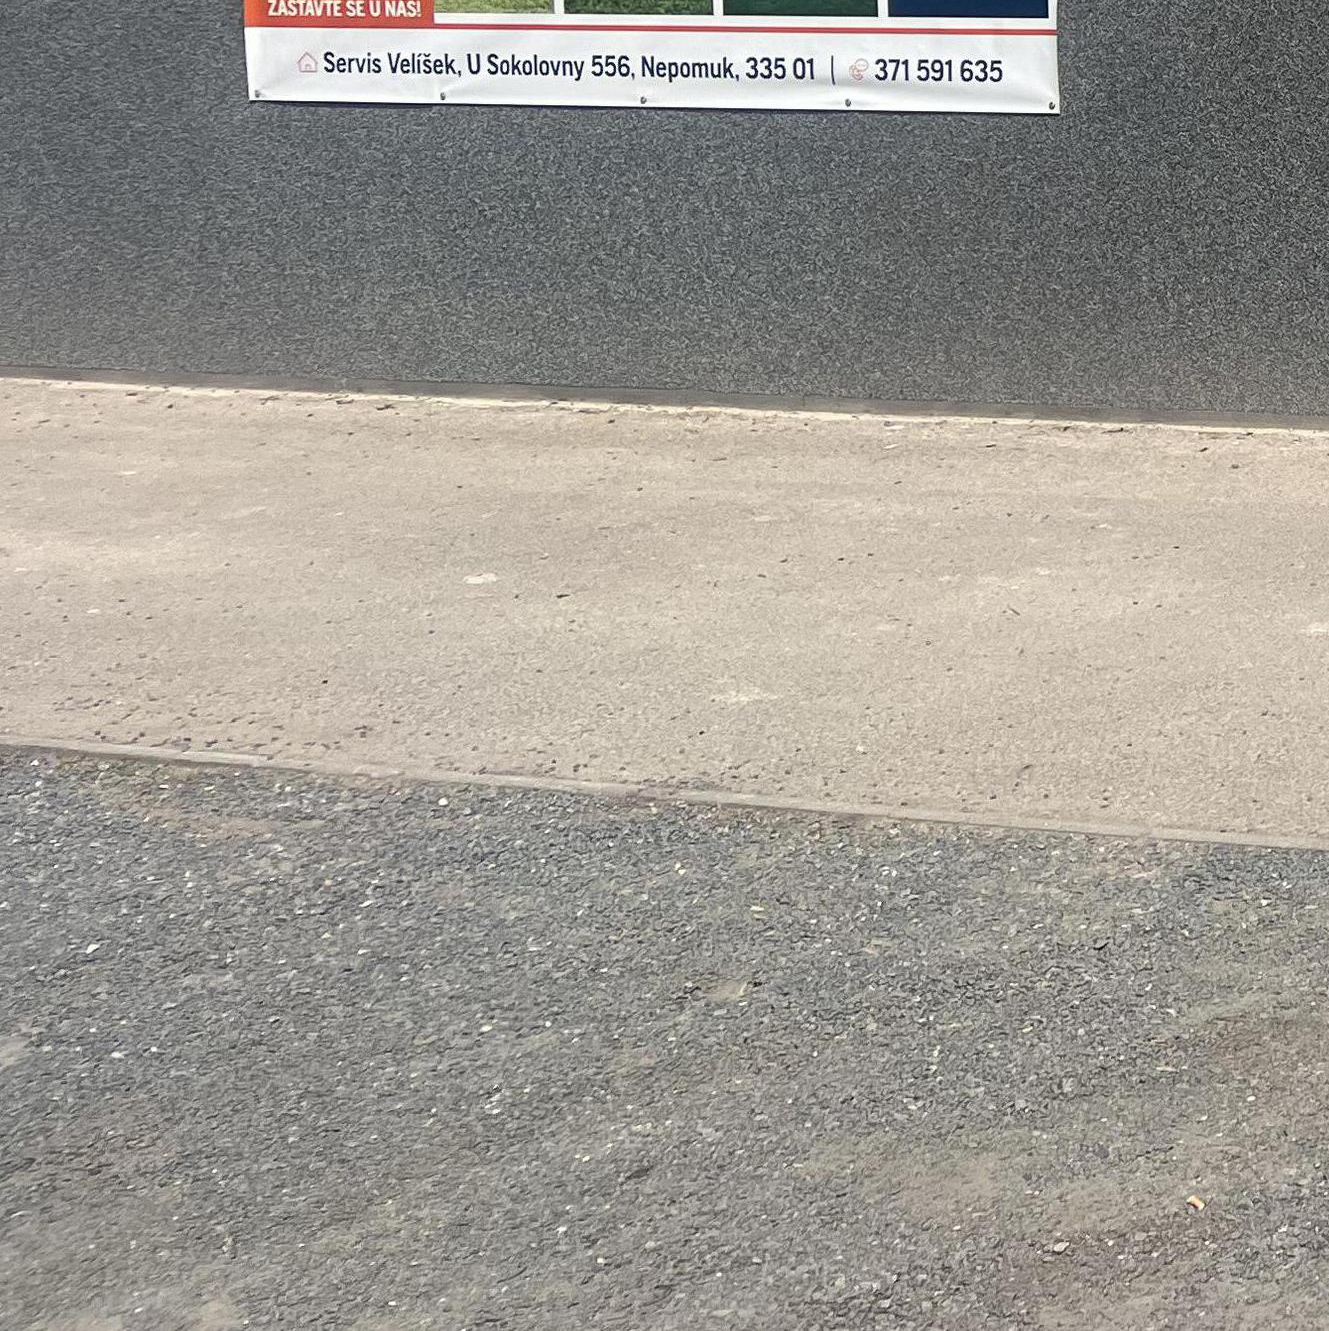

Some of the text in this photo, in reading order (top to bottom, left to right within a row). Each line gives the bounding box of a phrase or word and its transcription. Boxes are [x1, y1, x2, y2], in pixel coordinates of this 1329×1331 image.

[267, 0, 343, 17] ZASTAVTE
[345, 0, 363, 17] SE
[369, 0, 381, 17] U
[323, 51, 1003, 83] Servis Velíšek, U Sokolovny 556, Nepomuk, 335 01 371 591 635
